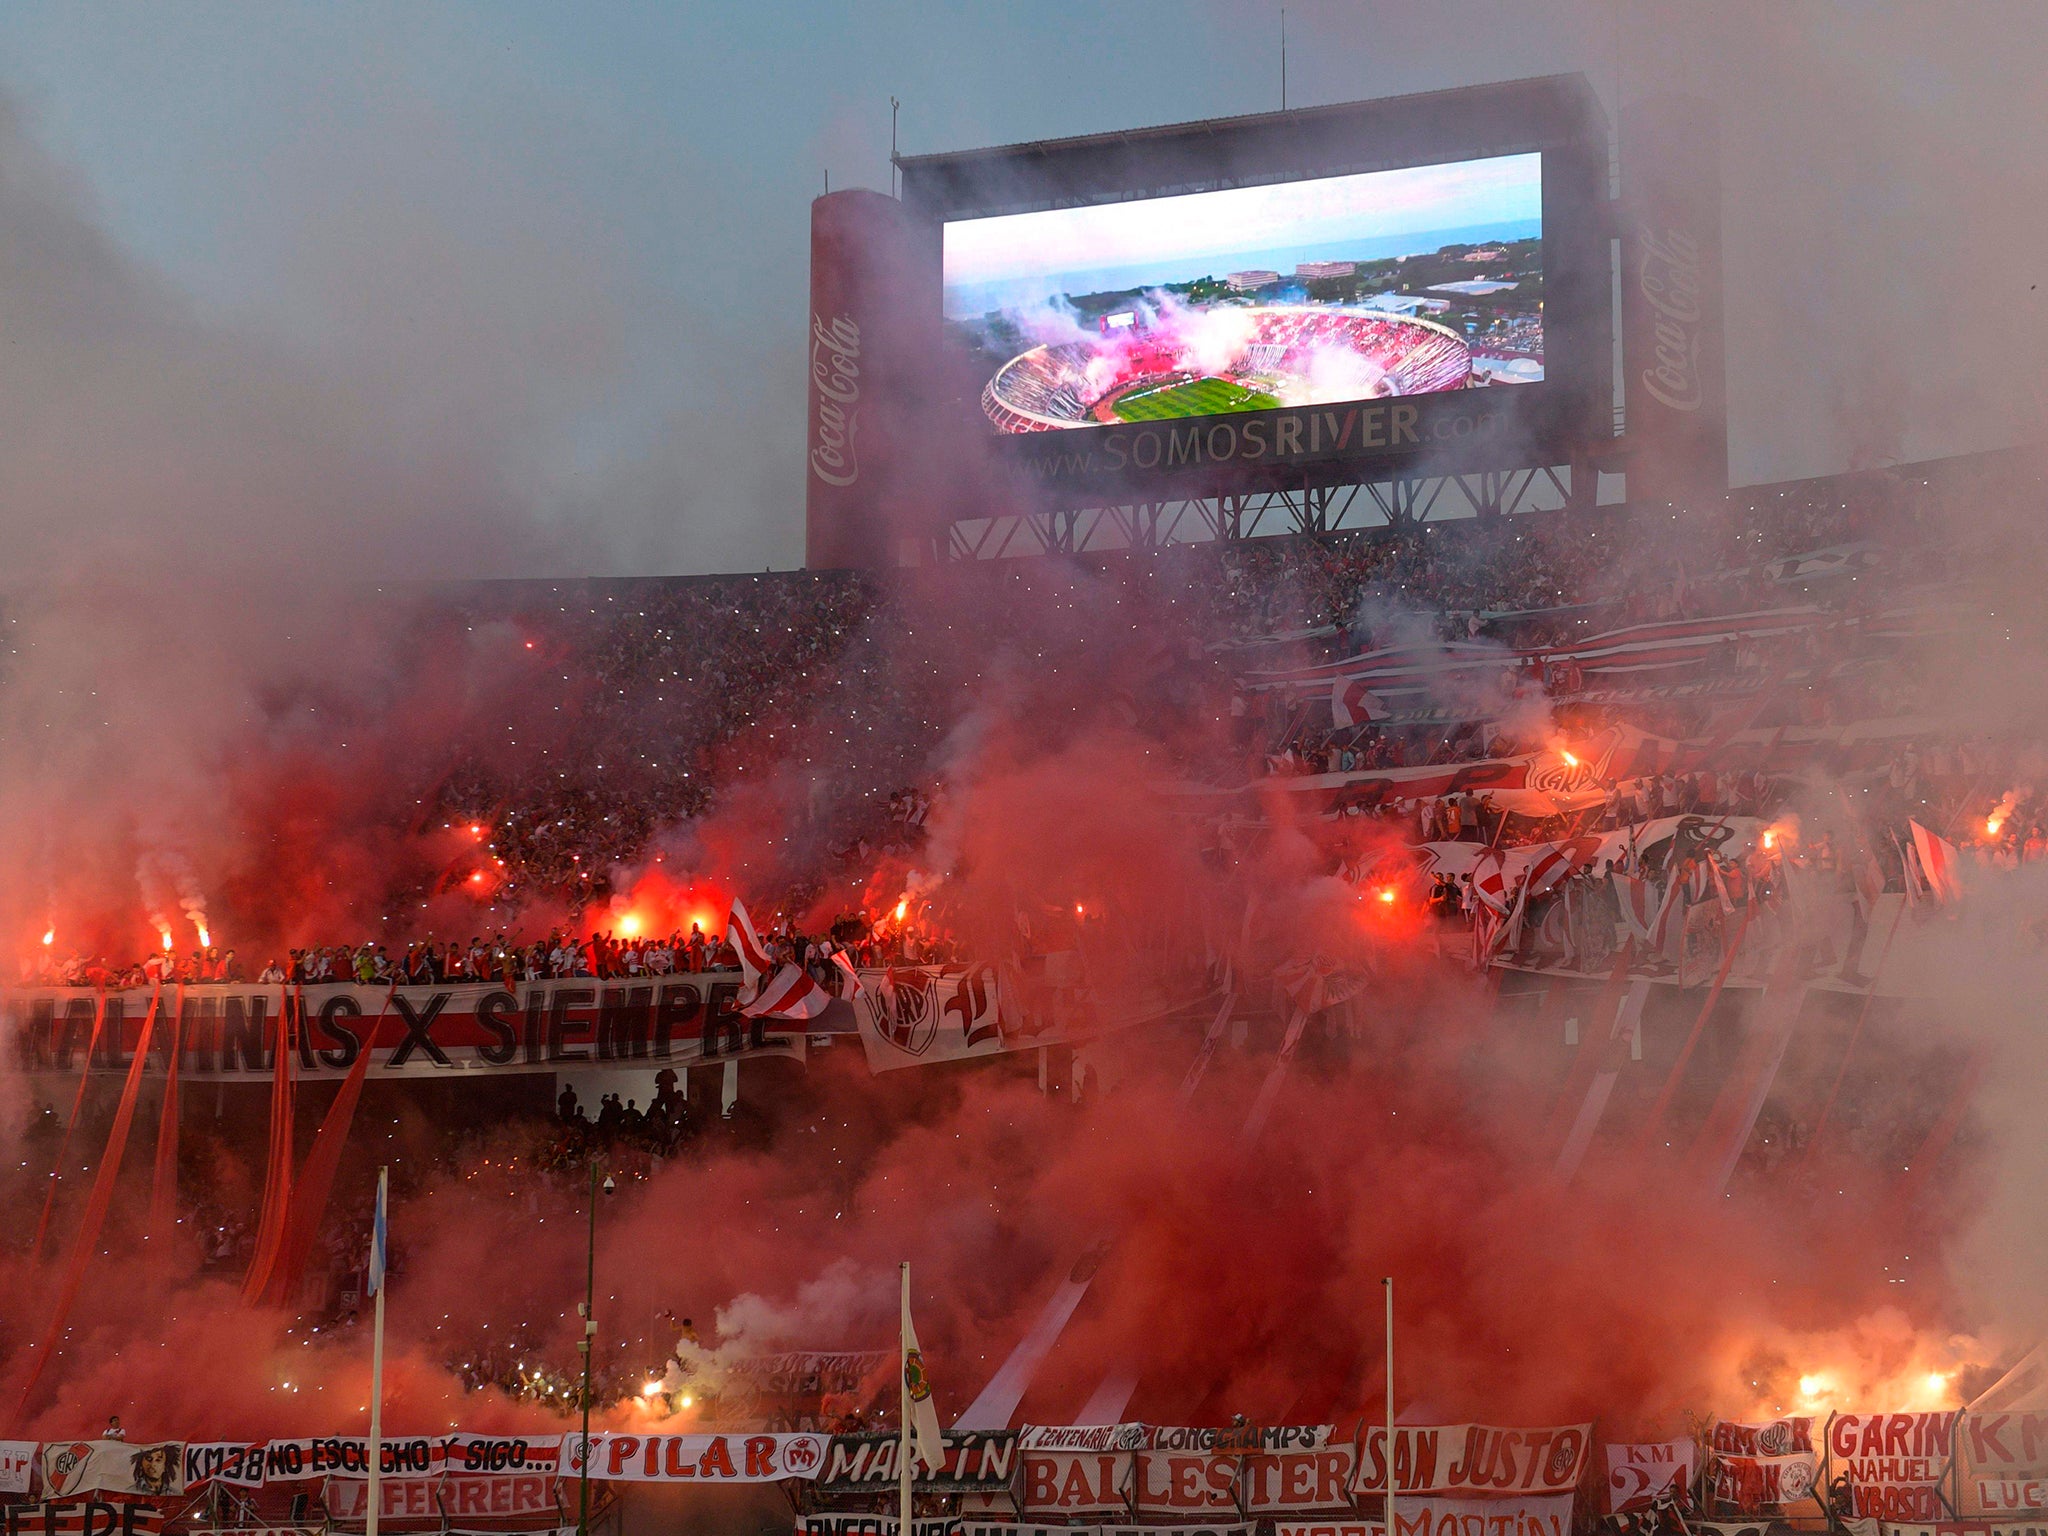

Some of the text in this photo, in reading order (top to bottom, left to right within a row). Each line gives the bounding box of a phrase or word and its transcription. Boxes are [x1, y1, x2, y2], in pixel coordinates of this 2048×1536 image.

[1639, 223, 1702, 411] Coca-Cola
[811, 312, 861, 487] Coca-Cola
[384, 992, 454, 1069] X
[269, 1443, 303, 1476] NO
[312, 1438, 430, 1473] ESCUCHO
[440, 1437, 460, 1468] Y
[608, 1436, 778, 1478] PILAR
[1363, 1426, 1583, 1490] SAN JUSTO
[1625, 1445, 1674, 1464] KM
[1832, 1412, 1955, 1458] GARIN
[1023, 1451, 1352, 1508] BALLESTER
[1849, 1459, 1939, 1482] NAHUEL
